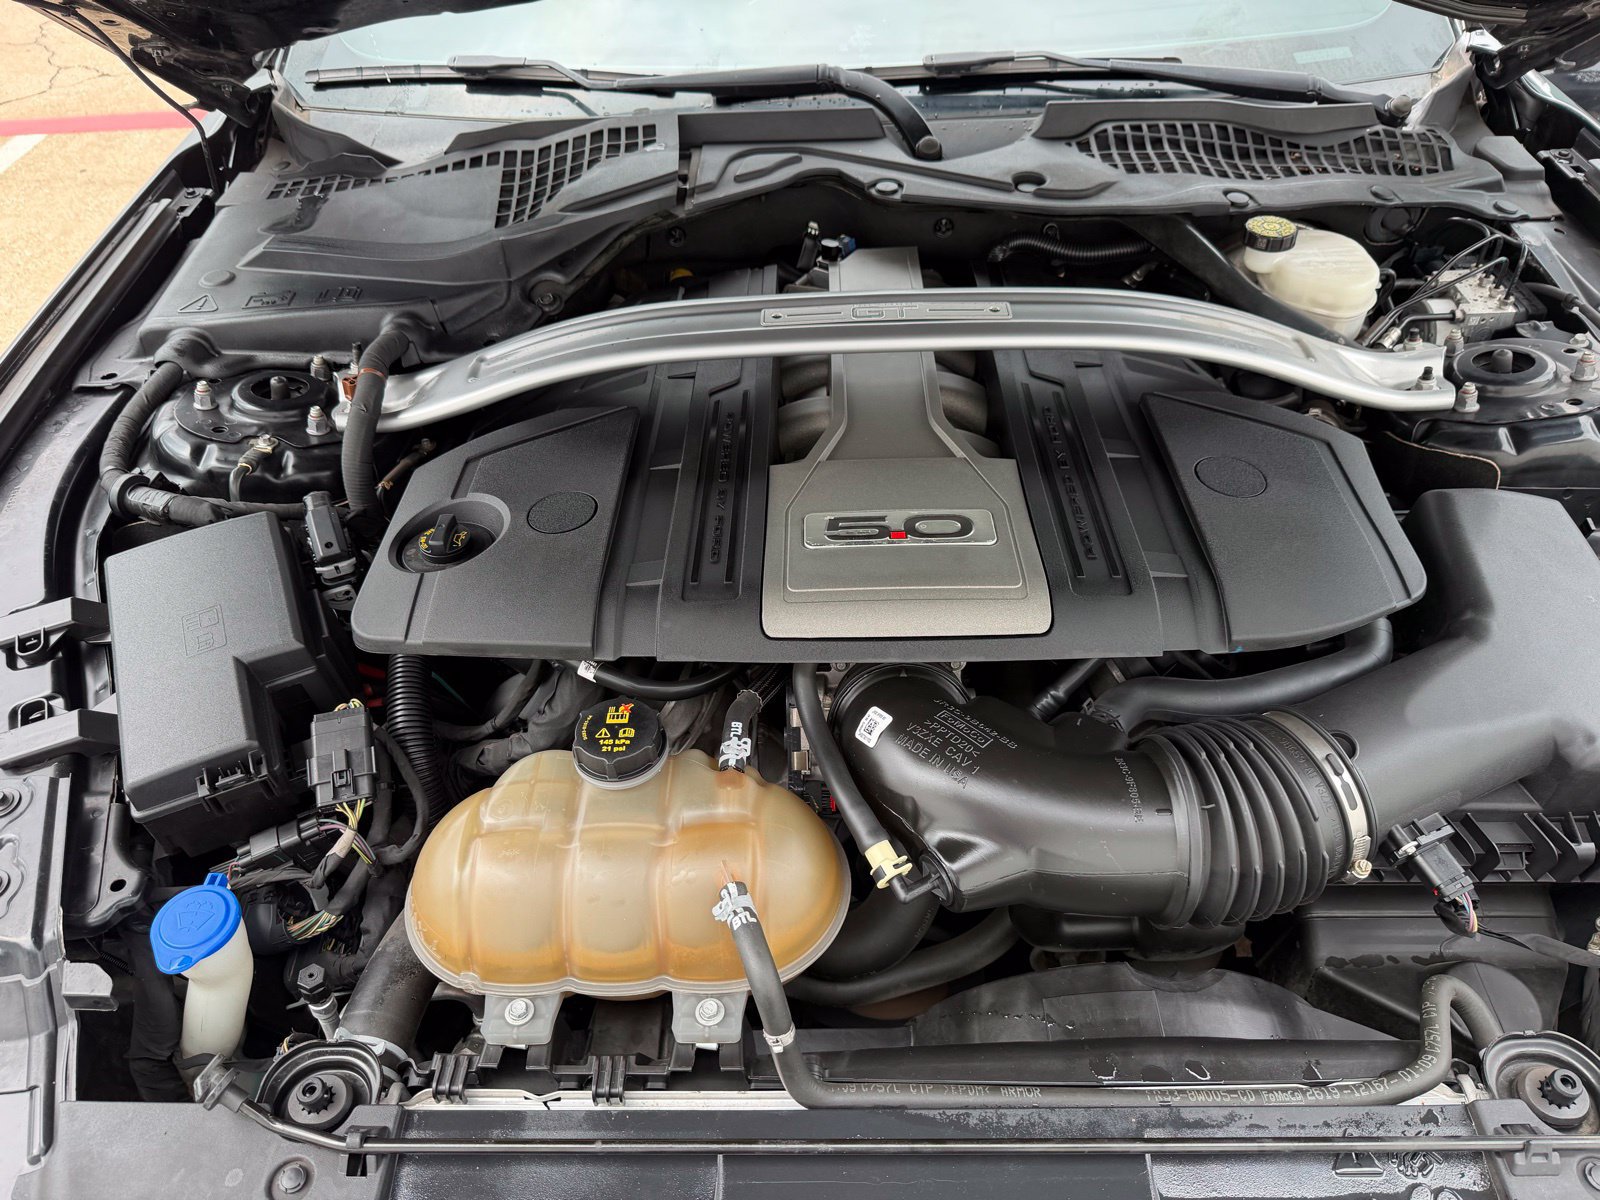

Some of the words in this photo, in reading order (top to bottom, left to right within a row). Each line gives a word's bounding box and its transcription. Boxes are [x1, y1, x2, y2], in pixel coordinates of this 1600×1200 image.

[851, 304, 918, 320] GT
[1042, 406, 1063, 444] FORD
[1055, 450, 1070, 469] BY
[1062, 474, 1097, 560] POWERED
[825, 515, 974, 541] 5.0
[940, 712, 985, 743] FoMoCo
[895, 733, 931, 759] MADE
[928, 753, 944, 768] IN
[944, 763, 968, 789] USA
[945, 746, 973, 767] CAV
[731, 911, 758, 931] BTL
[1000, 1085, 1042, 1098] ARMOR
[1261, 1089, 1302, 1102] FoMoCo
